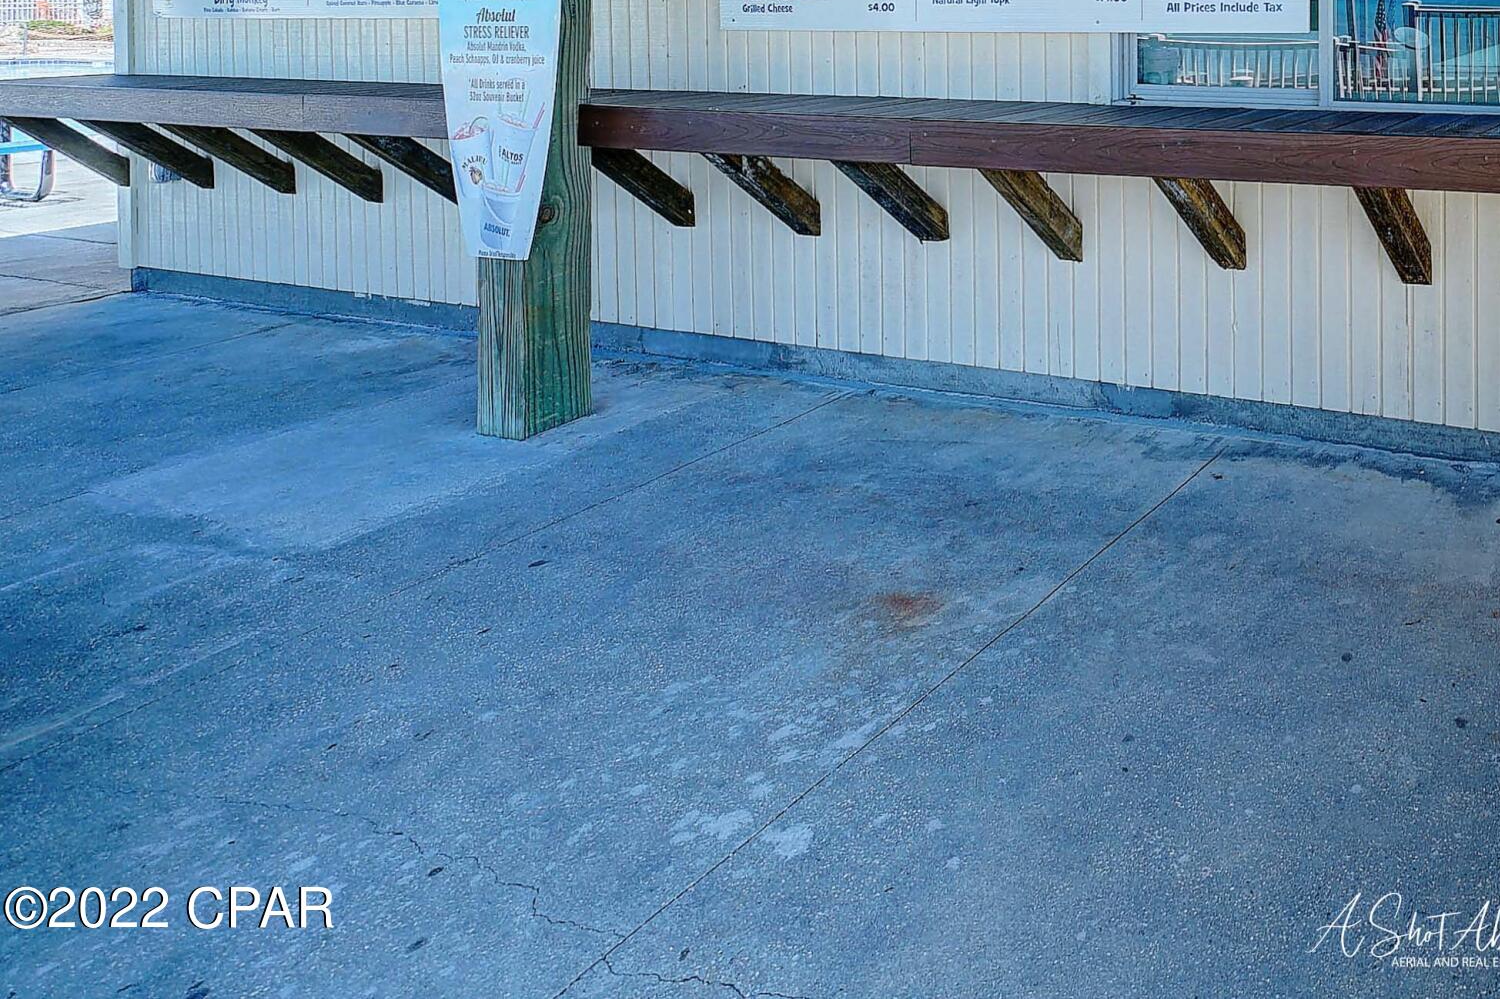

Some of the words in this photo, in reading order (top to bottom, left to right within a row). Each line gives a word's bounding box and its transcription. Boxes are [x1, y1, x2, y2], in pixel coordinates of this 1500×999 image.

[742, 4, 765, 13] Grilled
[768, 3, 793, 12] Cheese
[868, 3, 895, 12] $4.00
[1167, 2, 1180, 12] All
[1184, 2, 1216, 12] Prices
[1220, 2, 1259, 12] Include
[1264, 2, 1282, 12] Tax
[476, 8, 516, 24] Absolut
[464, 26, 492, 38] STRESS
[495, 26, 529, 38] RELIEVER
